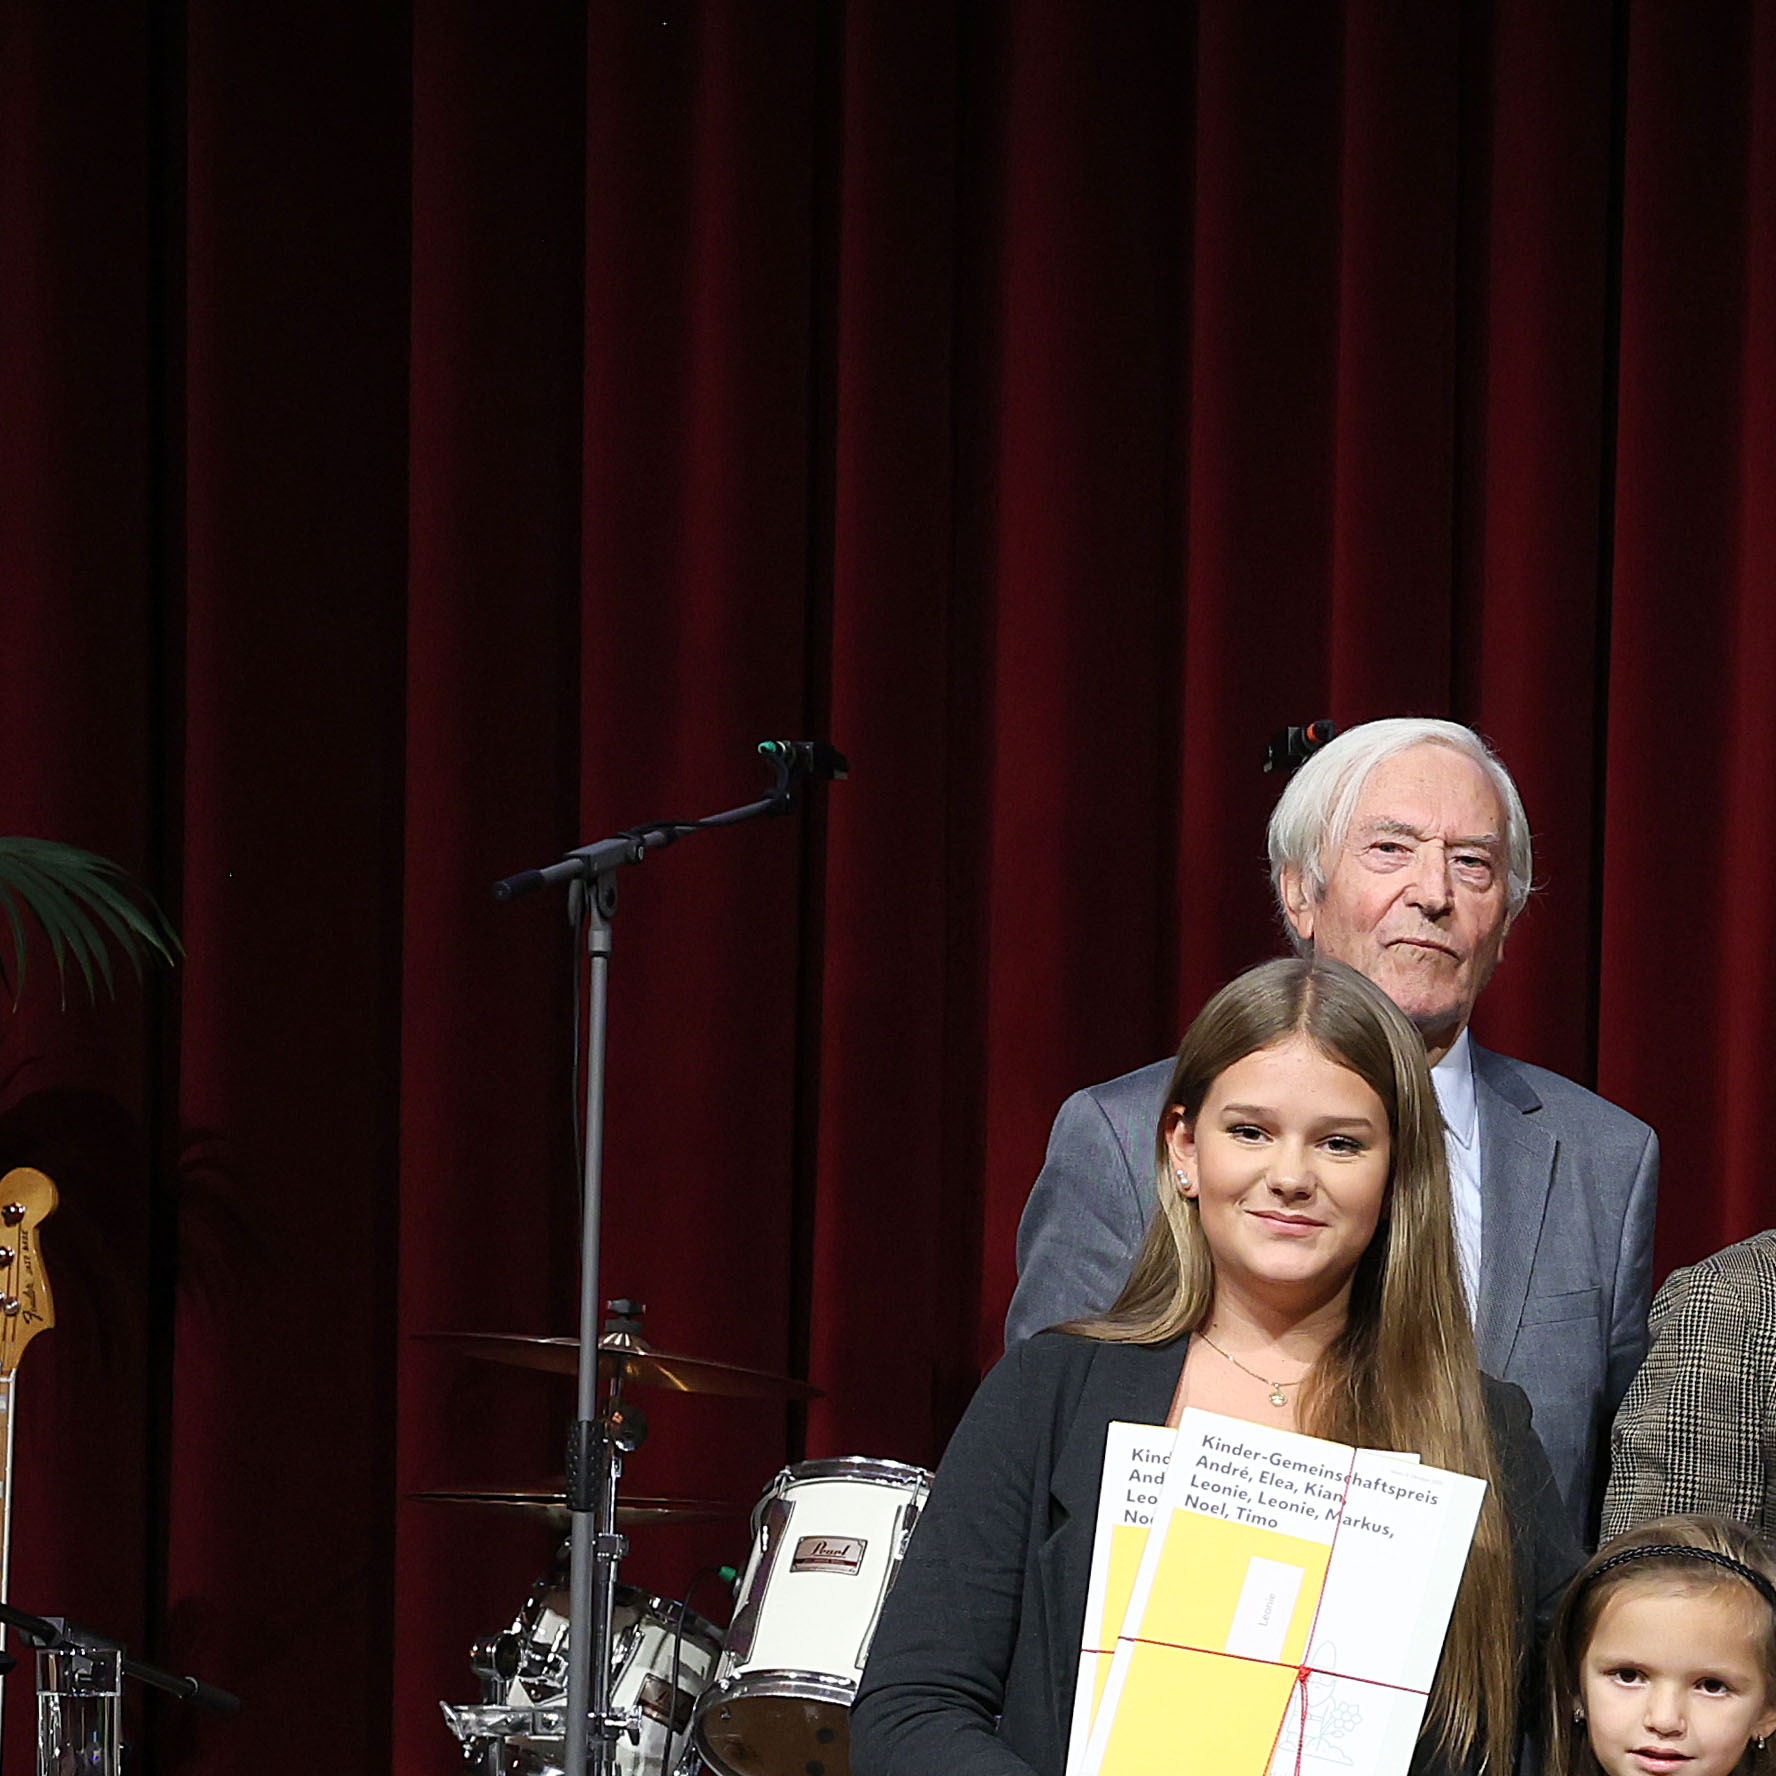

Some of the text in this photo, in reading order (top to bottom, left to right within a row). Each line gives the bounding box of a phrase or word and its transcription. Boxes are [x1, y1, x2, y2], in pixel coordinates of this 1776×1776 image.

[1129, 1469, 1165, 1485] And
[1196, 1455, 1252, 1482] André,
[1259, 1470, 1298, 1493] Elea,
[1202, 1435, 1438, 1505] Kinder-Gemeinschaftspreis
[1126, 1489, 1158, 1505] Leo
[1184, 1494, 1278, 1528] Noel, Timo
[1190, 1474, 1393, 1538] Leonie, Leonie, Markus,
[810, 1540, 851, 1557] Pearl
[1258, 1592, 1277, 1627] Leonie
